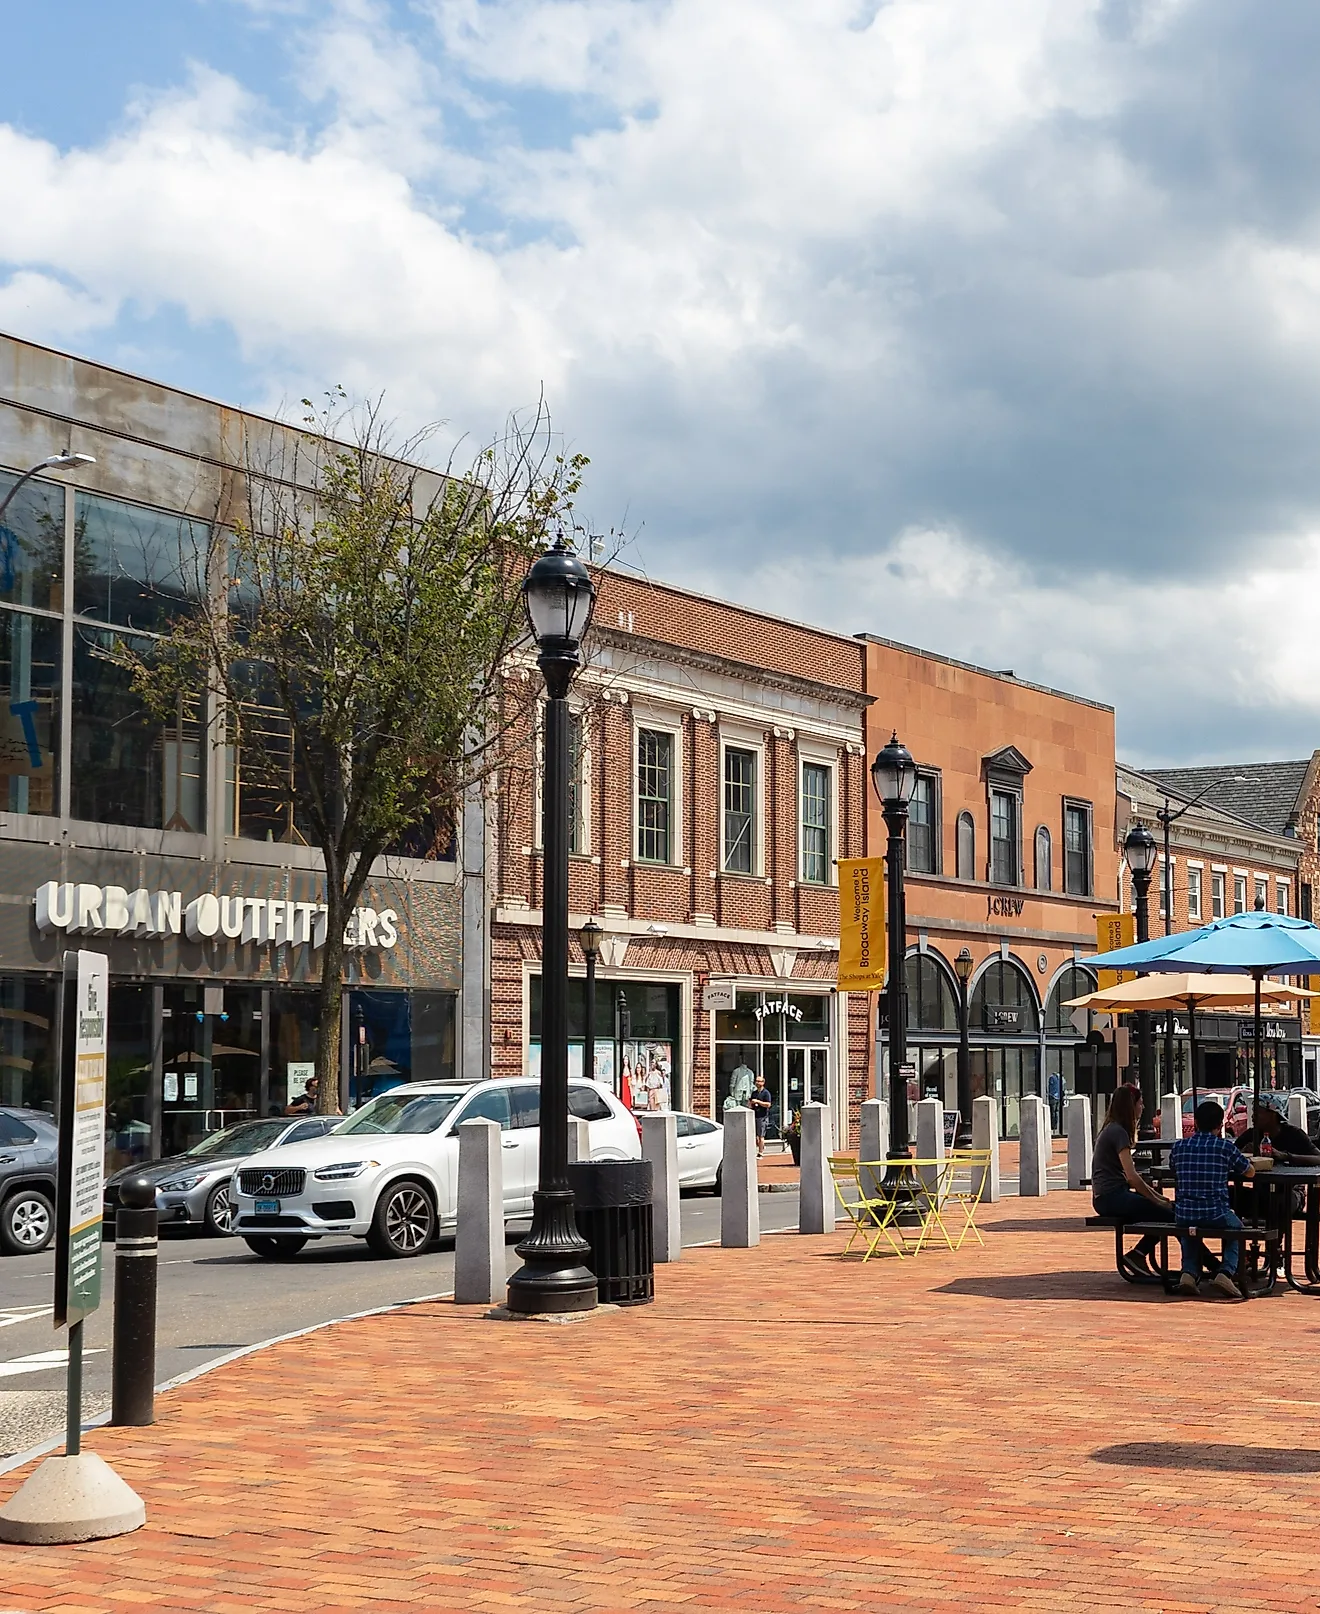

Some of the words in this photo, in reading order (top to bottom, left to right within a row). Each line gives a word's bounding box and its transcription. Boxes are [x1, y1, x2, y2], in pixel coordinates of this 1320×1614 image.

[852, 868, 859, 878] to
[860, 868, 870, 904] Island
[36, 881, 182, 939] URBAN
[853, 880, 861, 922] Welcome
[860, 908, 870, 968] Broadway
[849, 973, 865, 981] Shops
[707, 991, 731, 1000] FATFACE
[754, 1000, 804, 1022] FATFACE
